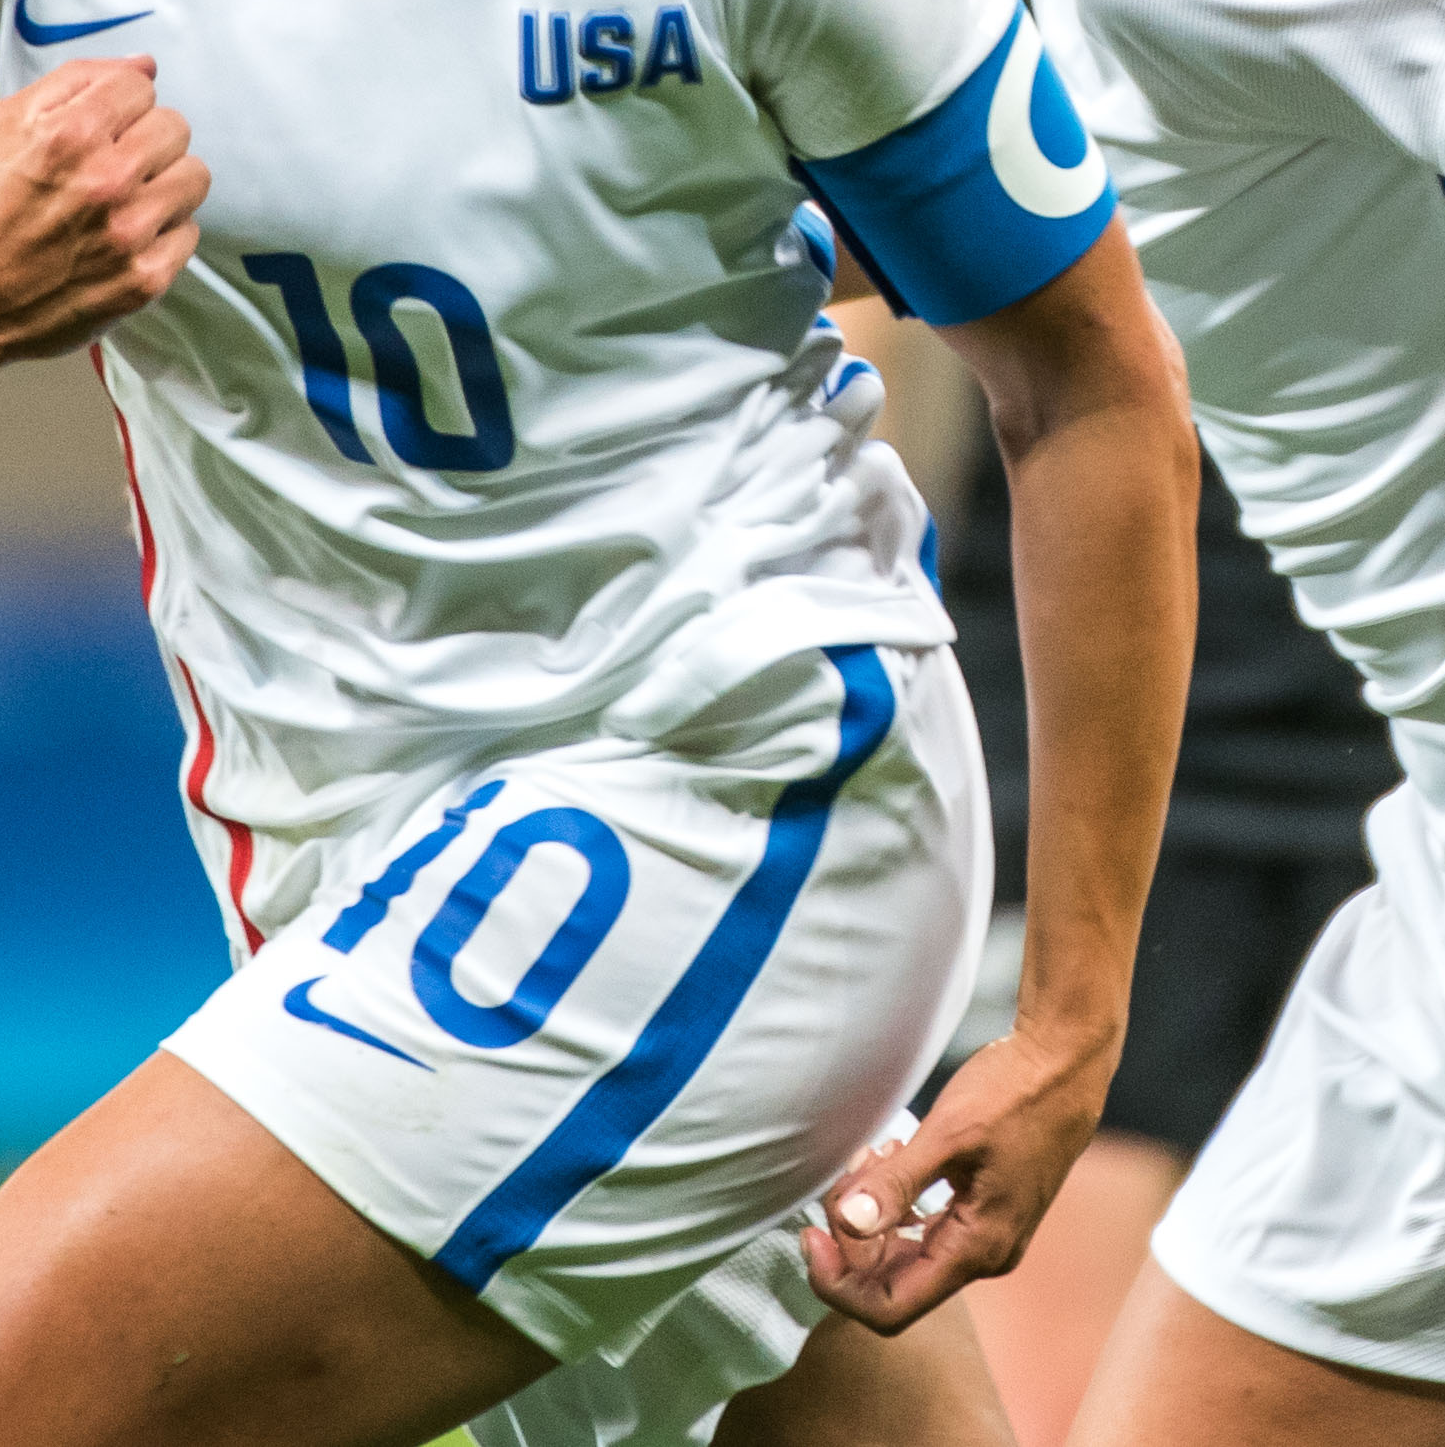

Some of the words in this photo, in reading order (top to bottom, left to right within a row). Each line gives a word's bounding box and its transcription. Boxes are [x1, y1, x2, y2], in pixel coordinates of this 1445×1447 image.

[519, 6, 703, 105] USA
[241, 252, 515, 471] 10
[321, 779, 631, 1049] 10
